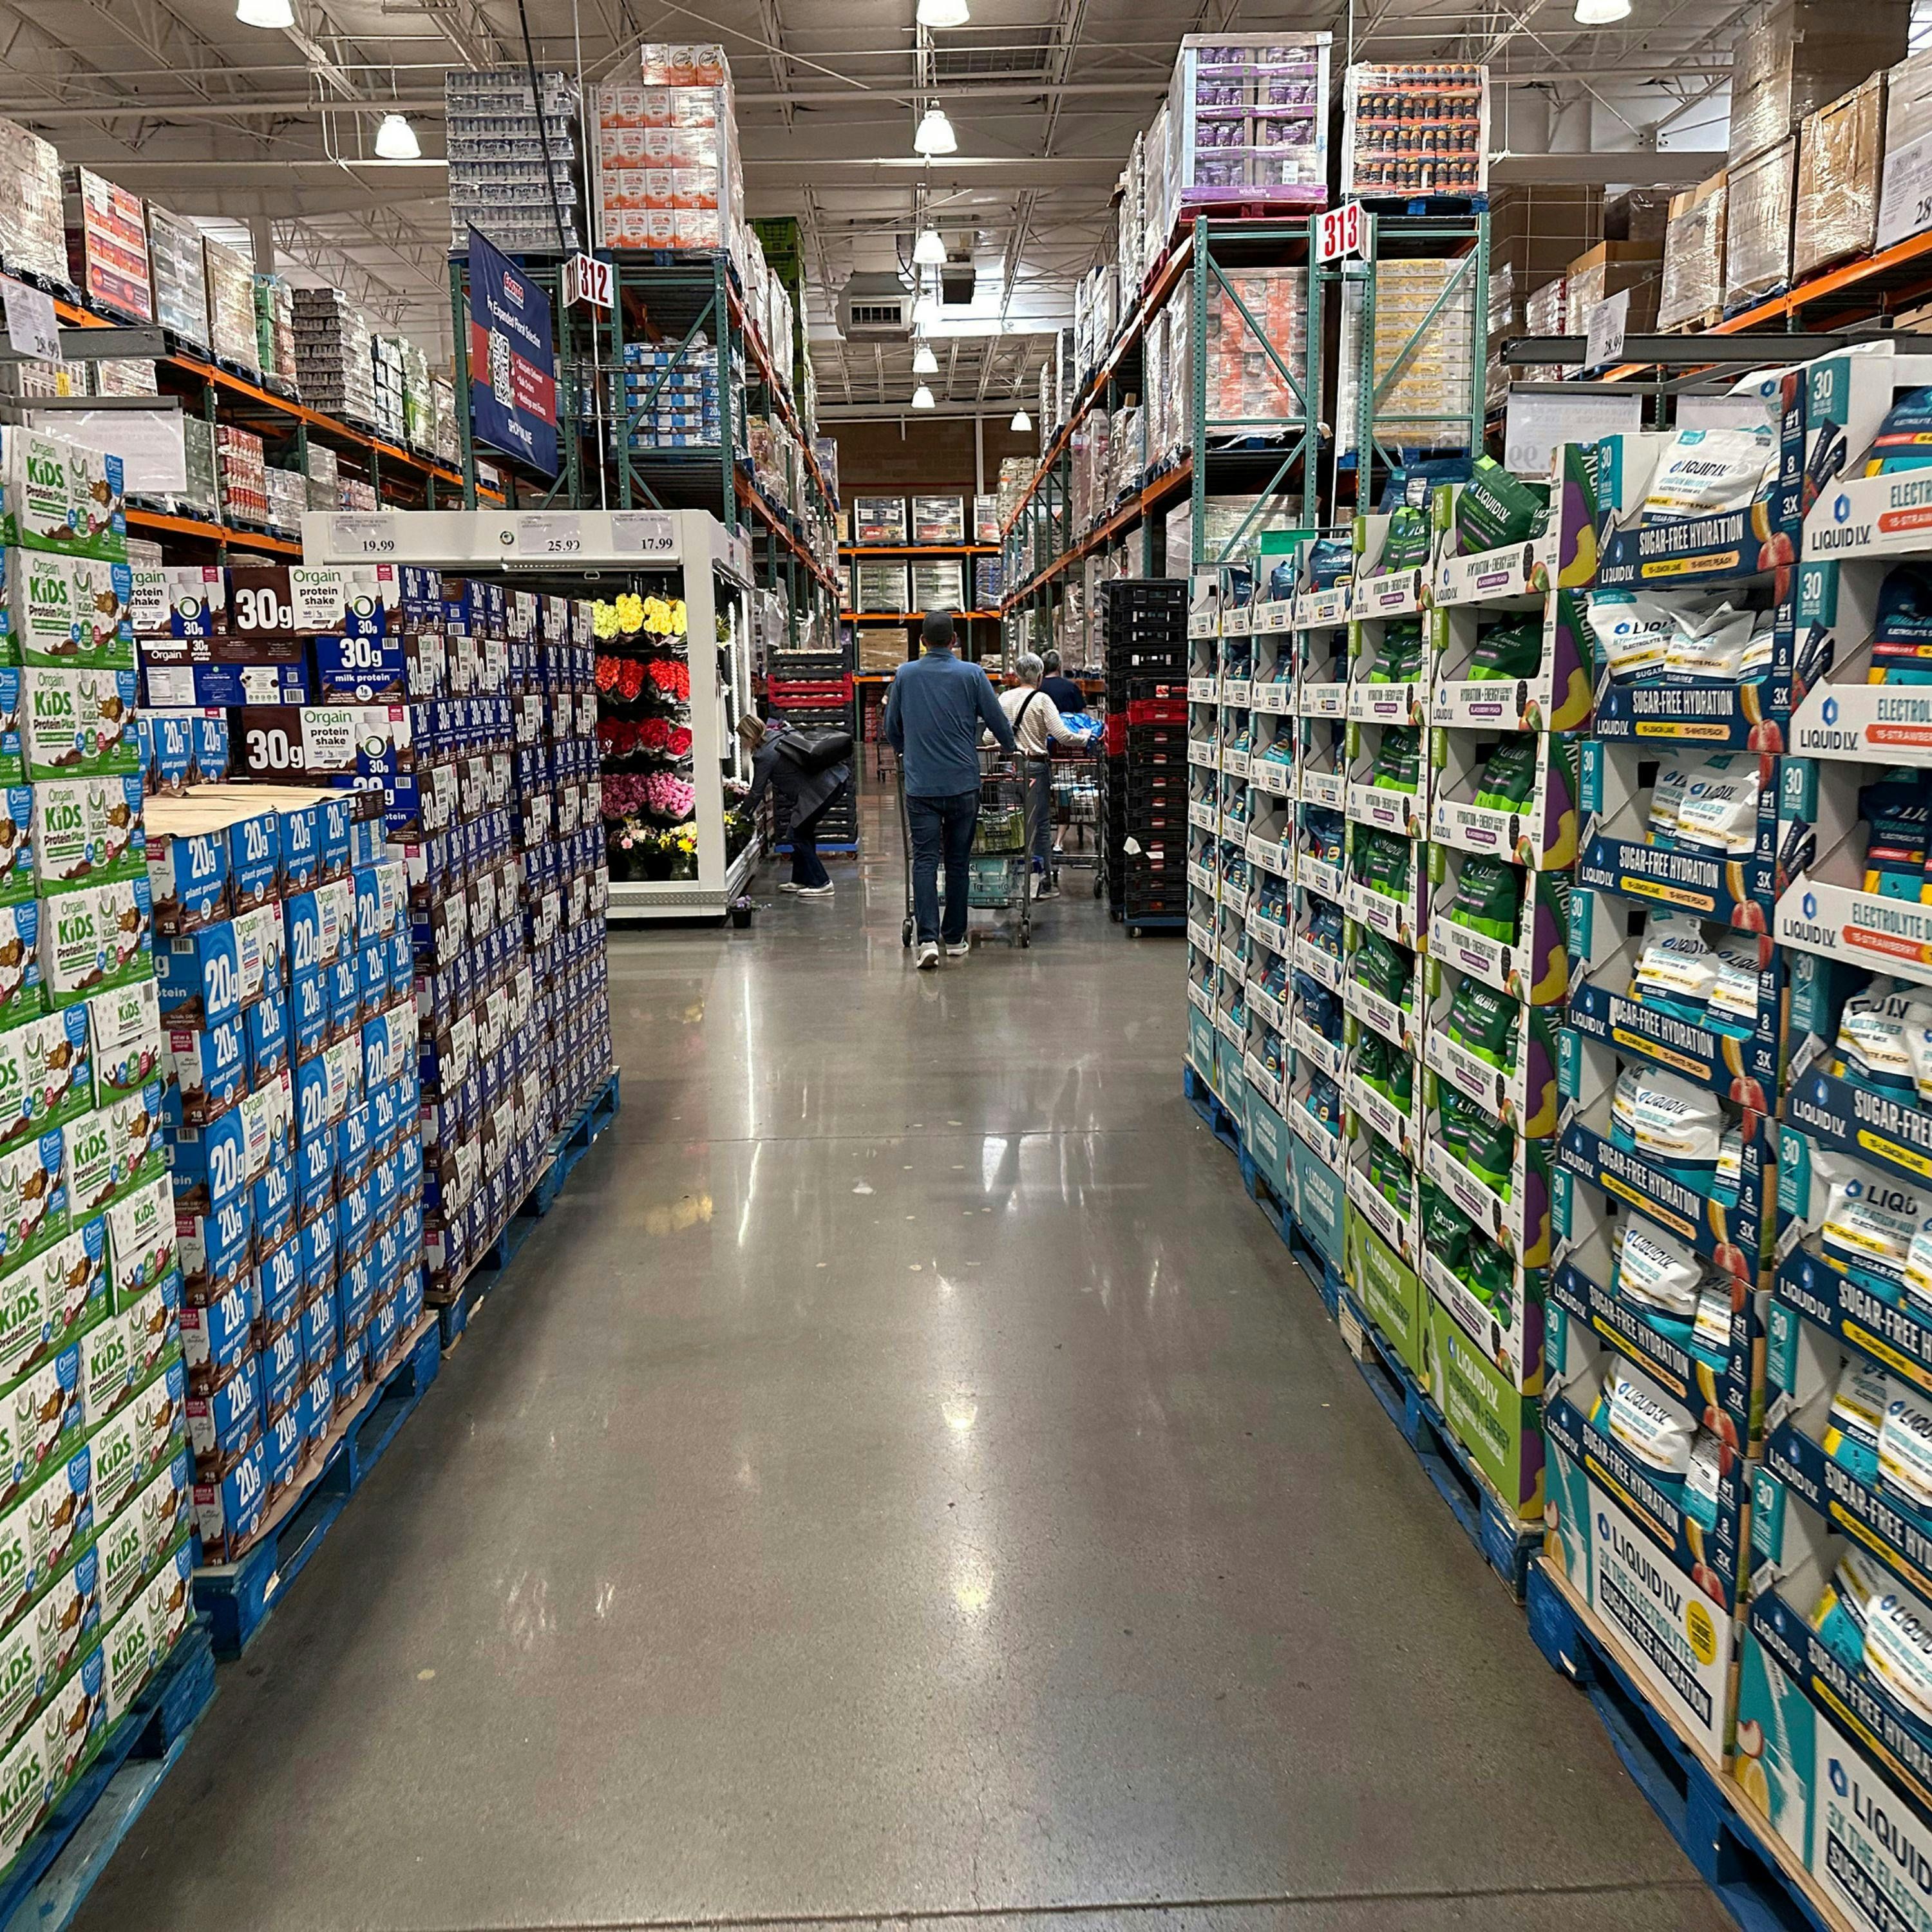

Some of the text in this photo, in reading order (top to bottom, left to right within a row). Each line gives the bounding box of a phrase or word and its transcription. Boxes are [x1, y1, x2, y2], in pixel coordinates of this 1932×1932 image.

[1324, 205, 1357, 256] 313
[580, 257, 609, 303] 312
[1814, 368, 1833, 401] 30
[1785, 408, 1799, 430] #1
[1787, 456, 1795, 474] 8
[1475, 486, 1501, 518] LIQUID
[1783, 495, 1799, 515] 3X
[363, 540, 394, 551] 19.99
[548, 540, 580, 551] 25.99
[641, 538, 672, 549] 17.99
[1639, 514, 1743, 556] SUGAR-FREE HYDRATION
[1812, 525, 1871, 551] LIQUID I.V.
[131, 570, 166, 586] rgain
[293, 569, 341, 585] Orgain
[1492, 556, 1507, 571] ENERGY
[1602, 567, 1625, 583] LIQUID
[299, 587, 338, 597] protein
[1436, 589, 1451, 601] LIQUID
[29, 605, 55, 618] Protein
[236, 588, 293, 630] 30g
[184, 621, 203, 635] 30g
[358, 620, 377, 634] 30g
[151, 650, 182, 661] Orgain
[339, 638, 382, 668] 30g
[335, 674, 390, 683] milk protein
[1460, 687, 1499, 702] HYDRATION ENERGY
[304, 710, 352, 726] Orgain
[1633, 690, 1733, 715] SUGAR-FREE HYDRATION
[1878, 698, 1932, 721] ELECTROL
[33, 719, 61, 730] Protein
[164, 721, 184, 753] 20g
[202, 721, 221, 751] 20g
[310, 729, 349, 738] protein
[1597, 720, 1620, 735] LIQUID
[1801, 730, 1858, 751] LIQUID I.V.
[247, 729, 304, 769] 30g
[1583, 751, 1594, 772] 30
[370, 760, 390, 773] 30g
[327, 804, 345, 839] 20g
[421, 793, 438, 832] 30g
[44, 833, 72, 846] Protein
[244, 820, 269, 861] 20g
[290, 813, 311, 850] 20g
[189, 837, 217, 878] 20g
[1619, 845, 1719, 889] SUGAR-FREE HYDRATION
[185, 880, 222, 900] plant protein
[1582, 866, 1605, 886] LIQUID
[1757, 871, 1772, 889] 3X
[236, 916, 258, 936] Orgain
[359, 893, 381, 938] 20g
[1784, 918, 1820, 945] LIQUID
[1852, 903, 1922, 939] ELECTROLYTE
[57, 945, 84, 960] Protein
[293, 918, 321, 969] 20g
[156, 987, 187, 998] otein
[205, 954, 240, 1015] 20g
[301, 979, 321, 1016] 20g
[260, 1000, 281, 1037] 20g
[213, 1023, 238, 1067] 20g
[1661, 1011, 1714, 1059] HYDRATION
[302, 1081, 328, 1135] 20g
[1793, 1098, 1831, 1131] LIQUID
[1854, 1090, 1932, 1150] SUGAR-FREE
[73, 1162, 97, 1182] Protein
[210, 1138, 245, 1200] 20g
[307, 1140, 328, 1179] 20g
[265, 1167, 287, 1209] 20g
[1597, 1141, 1700, 1220] SUGAR-FREE HYDRATION
[217, 1202, 242, 1247] 20g
[311, 1218, 331, 1258] 20g
[1633, 1235, 1663, 1261] LIQUID
[272, 1249, 294, 1293] 20g
[221, 1289, 245, 1335] 20g
[1780, 1277, 1815, 1315] LIQUID
[1589, 1285, 1689, 1380] SUGAR-FREE HYDRATION
[1839, 1280, 1919, 1354] SUGAR-FREE
[90, 1372, 115, 1394] Protein
[228, 1373, 252, 1421] 20g
[275, 1412, 296, 1454] 20g
[96, 1468, 122, 1495] Protein
[236, 1458, 261, 1507] 20g
[1582, 1424, 1679, 1527] SUGAR-FREE HYDRATION
[1824, 1461, 1904, 1546] SUGAR-FREE
[106, 1564, 129, 1592] Protein
[1612, 1527, 1683, 1622] LIQUID I.V.
[1628, 1581, 1698, 1674] ELECTROLYTES
[1602, 1580, 1654, 1654] SUGAR-FREE
[1653, 1645, 1710, 1722] HYDRATION
[1852, 1781, 1932, 1895] LIQUID
